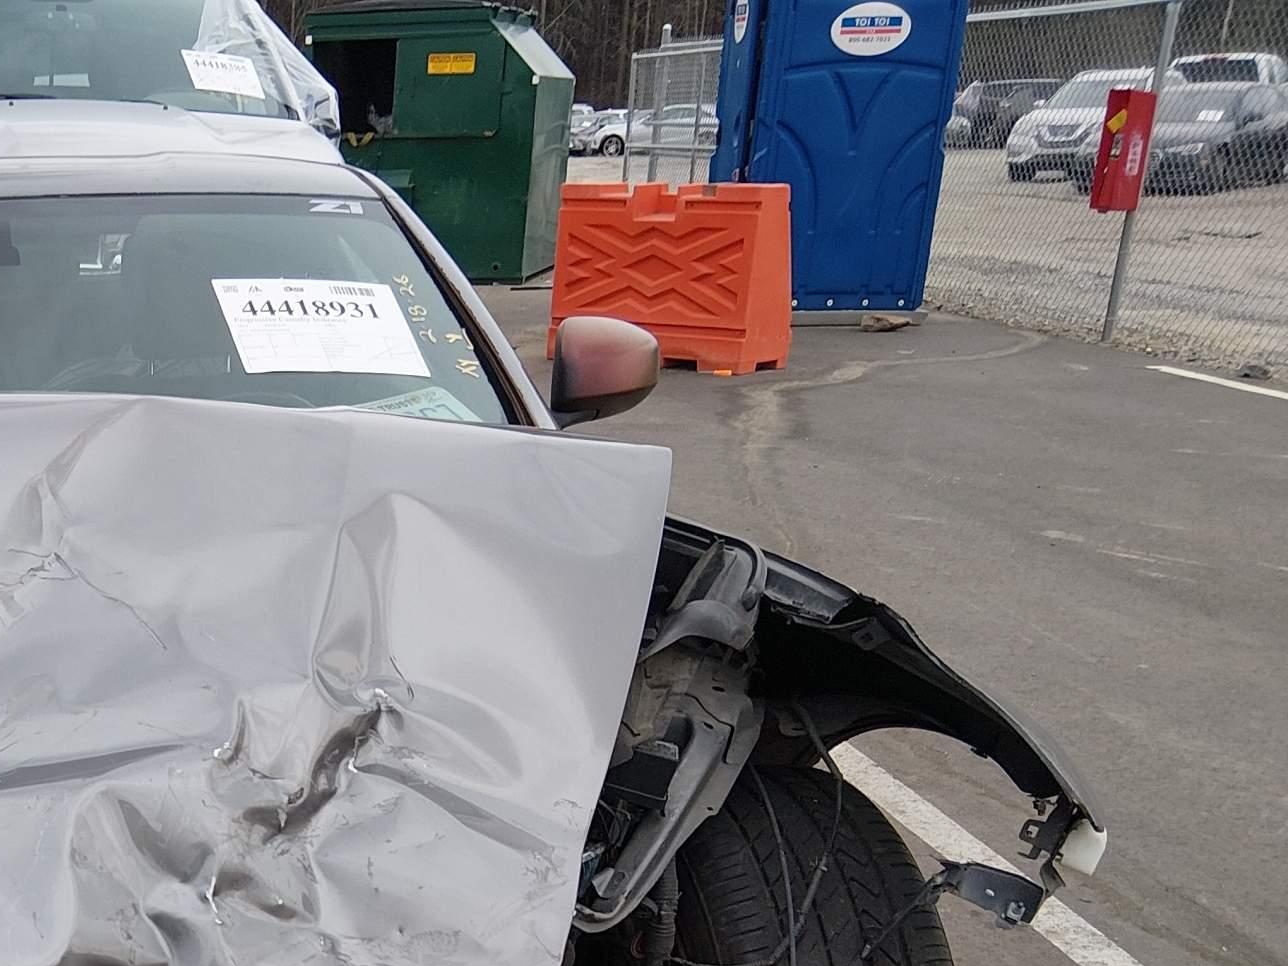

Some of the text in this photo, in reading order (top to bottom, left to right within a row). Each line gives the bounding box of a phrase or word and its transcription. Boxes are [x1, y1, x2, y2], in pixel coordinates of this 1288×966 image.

[855, 16, 891, 27] TOI TOI
[241, 299, 381, 320] 44418931
